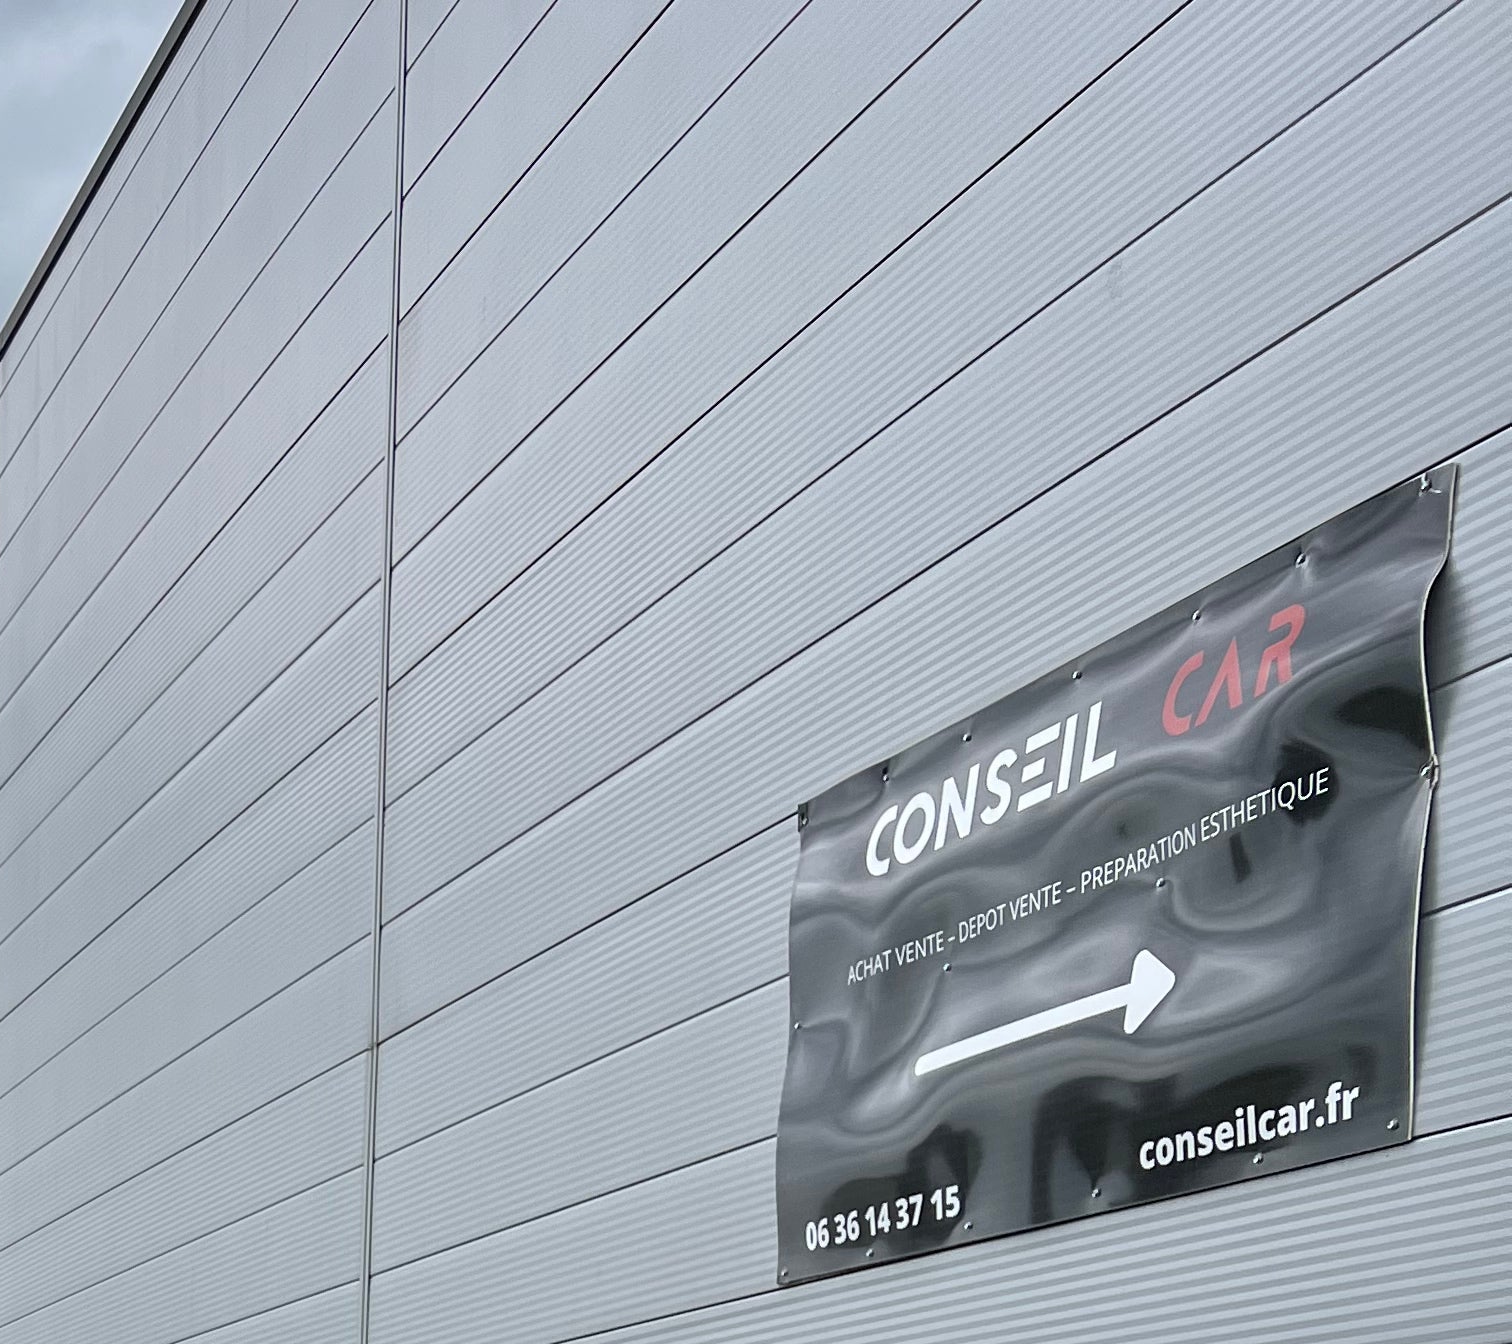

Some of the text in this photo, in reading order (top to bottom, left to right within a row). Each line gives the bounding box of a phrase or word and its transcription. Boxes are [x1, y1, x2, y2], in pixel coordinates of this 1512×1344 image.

[865, 604, 1306, 876] CONSEIL CAR
[847, 949, 892, 986] ACHAT
[894, 930, 944, 966] VENTE
[958, 903, 1006, 944] DEPOT
[1009, 881, 1062, 921] VENTE
[1080, 823, 1197, 894] PREPARATION
[1200, 767, 1330, 843] ESTHETIQUE
[1139, 1081, 1360, 1170] conseilcar.fr
[805, 1184, 961, 1251] 06 36 14 37 15
